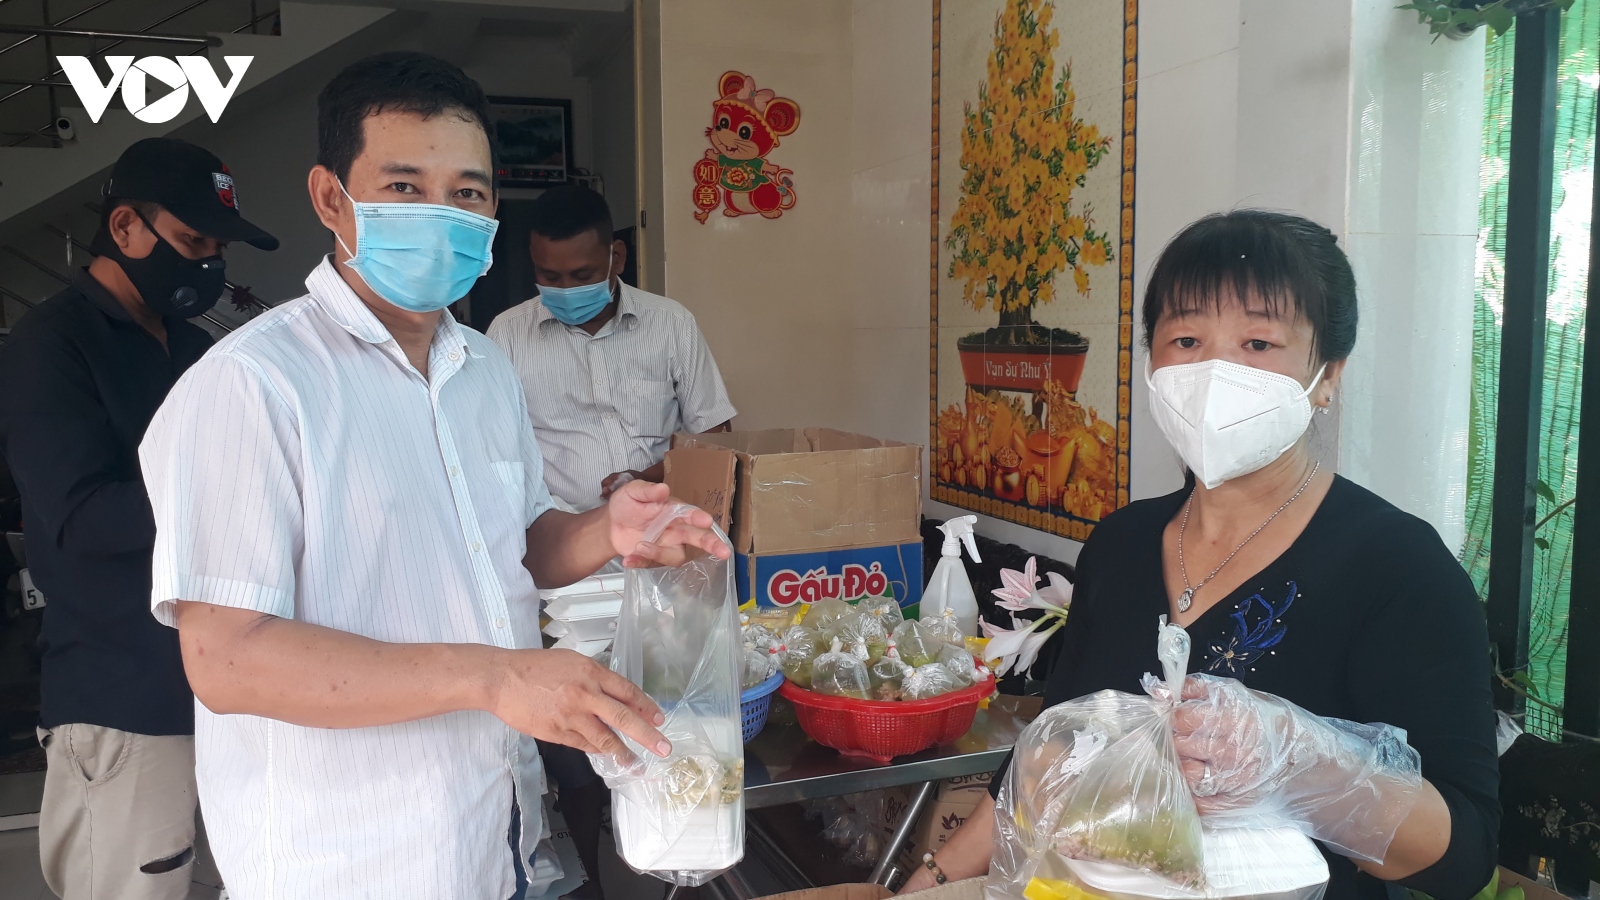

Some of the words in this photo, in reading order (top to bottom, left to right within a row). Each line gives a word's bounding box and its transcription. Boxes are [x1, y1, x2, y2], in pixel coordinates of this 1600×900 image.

[698, 164, 716, 205] 如意
[985, 360, 1003, 380] Vạn
[1005, 361, 1019, 381] Sự
[26, 589, 37, 606] 5
[768, 566, 842, 606] Gấu
[842, 561, 887, 600] Đỏ
